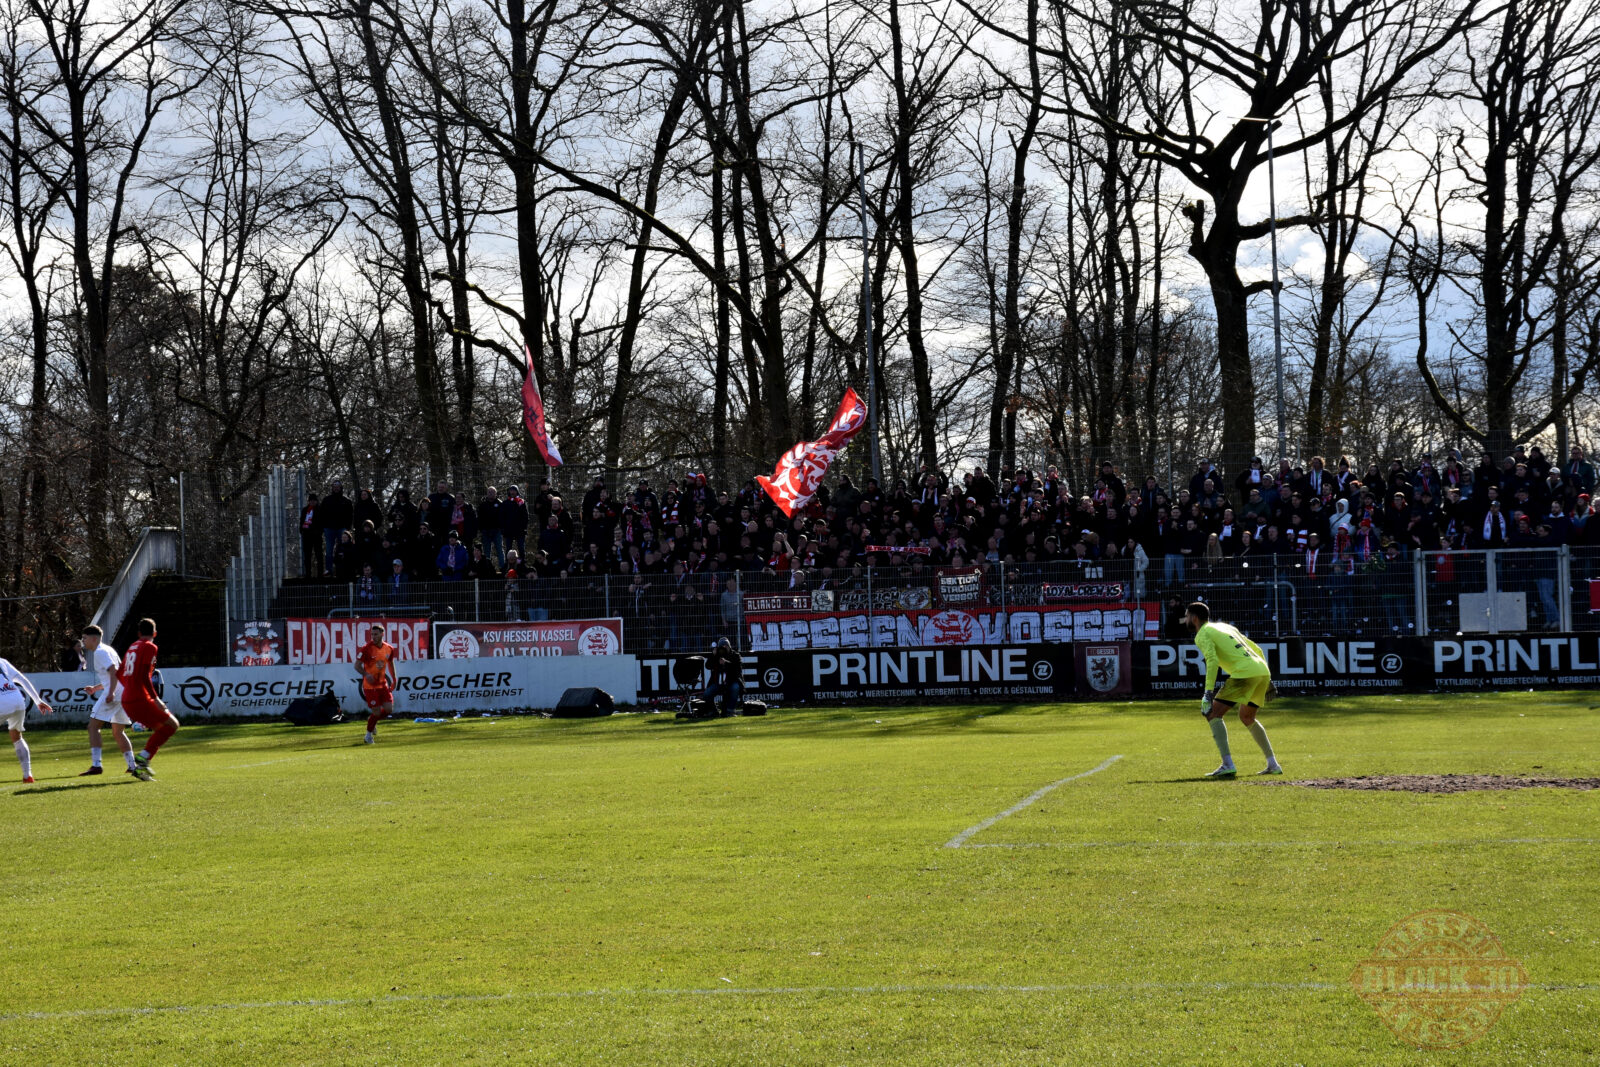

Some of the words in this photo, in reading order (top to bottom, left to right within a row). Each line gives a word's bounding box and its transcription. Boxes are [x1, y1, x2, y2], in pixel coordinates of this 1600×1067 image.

[483, 631, 502, 643] KSV
[503, 630, 540, 642] HESSEN
[540, 628, 576, 642] KASSEL
[1434, 638, 1600, 672] PRINTL
[812, 649, 1028, 686] PRINTLINE
[396, 672, 512, 692] ROSCHER
[408, 688, 524, 701] SICHERHEITSDIENST
